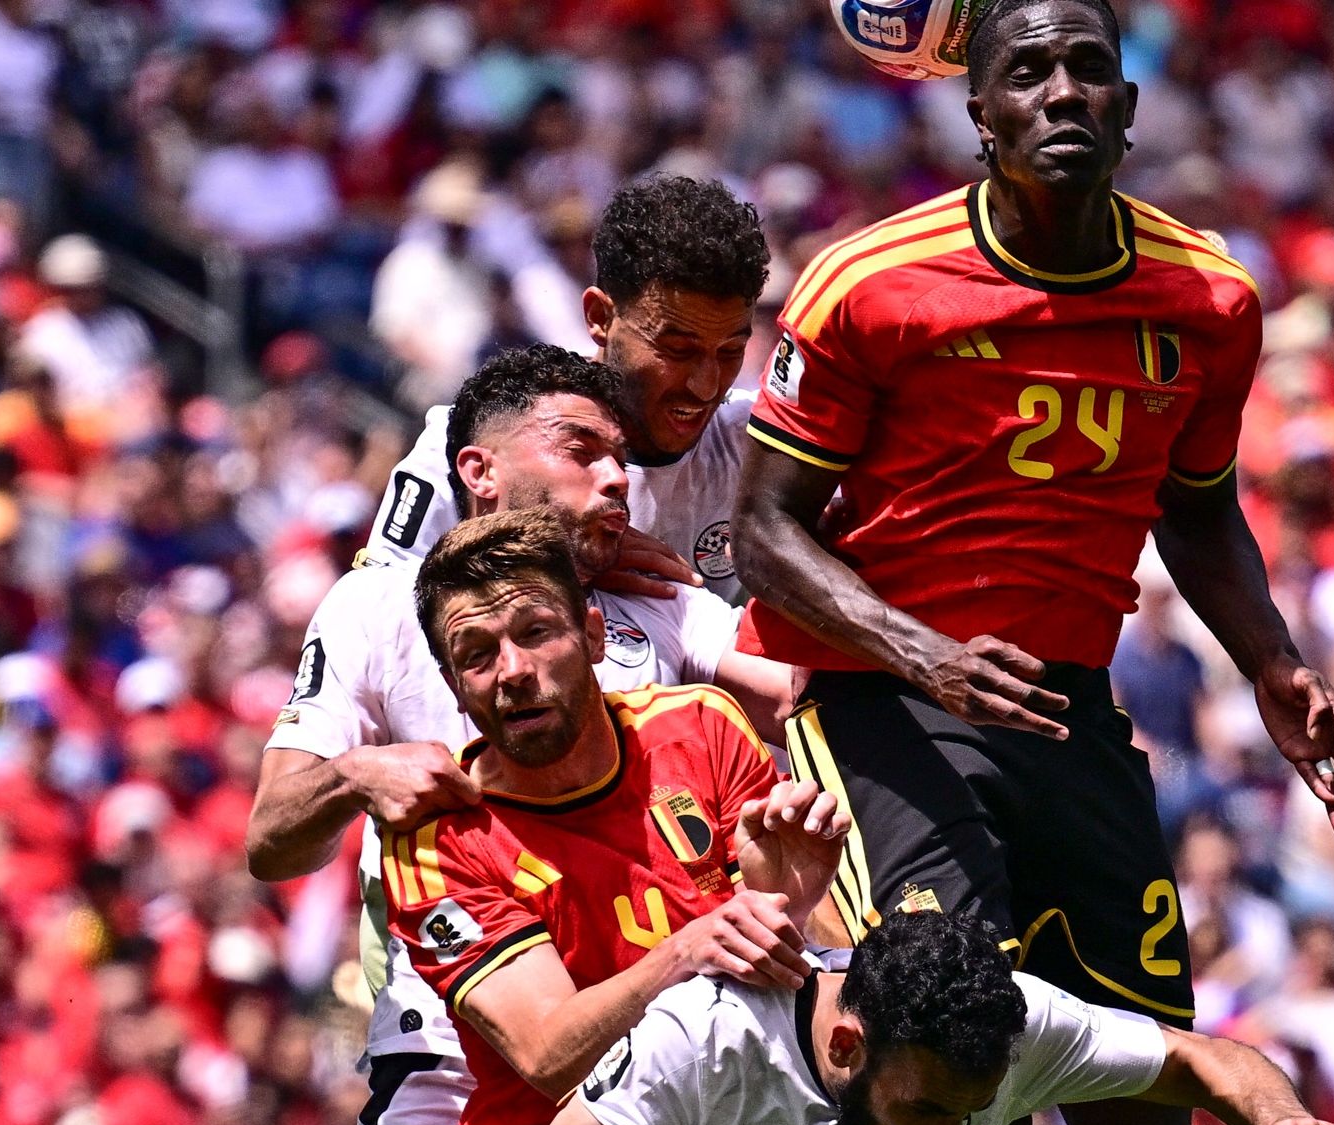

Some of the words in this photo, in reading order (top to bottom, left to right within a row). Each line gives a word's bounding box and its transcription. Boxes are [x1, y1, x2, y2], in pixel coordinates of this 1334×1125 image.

[946, 0, 971, 53] TRIONDA
[1008, 385, 1125, 480] 24
[613, 887, 672, 950] 4
[1140, 879, 1181, 976] 2
